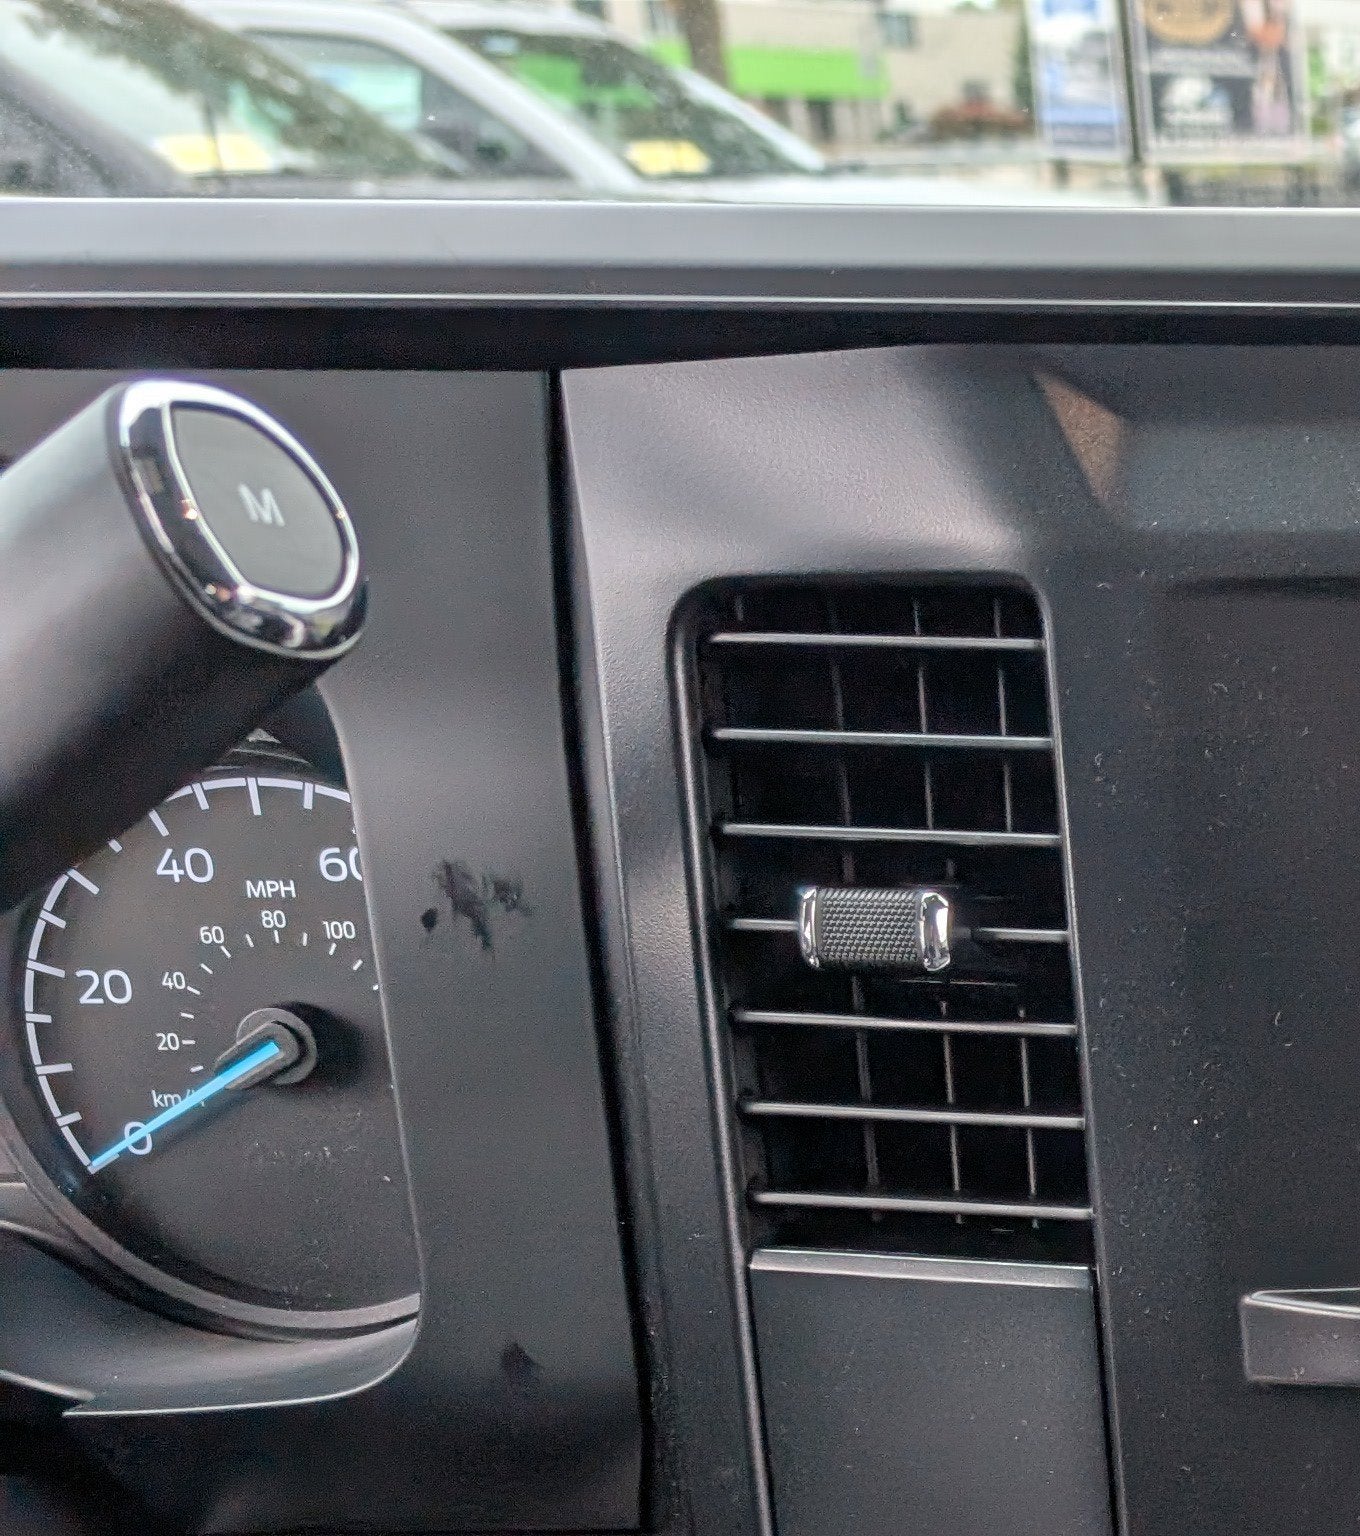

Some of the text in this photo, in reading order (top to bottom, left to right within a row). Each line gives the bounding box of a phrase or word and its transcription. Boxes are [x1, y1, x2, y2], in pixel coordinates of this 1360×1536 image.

[156, 847, 214, 884] 40
[246, 880, 296, 899] MPH
[261, 910, 287, 929] 80
[199, 925, 225, 945] 60
[322, 921, 356, 940] 100
[76, 969, 132, 1004] 20
[161, 972, 186, 990] 40
[156, 1033, 180, 1051] 20
